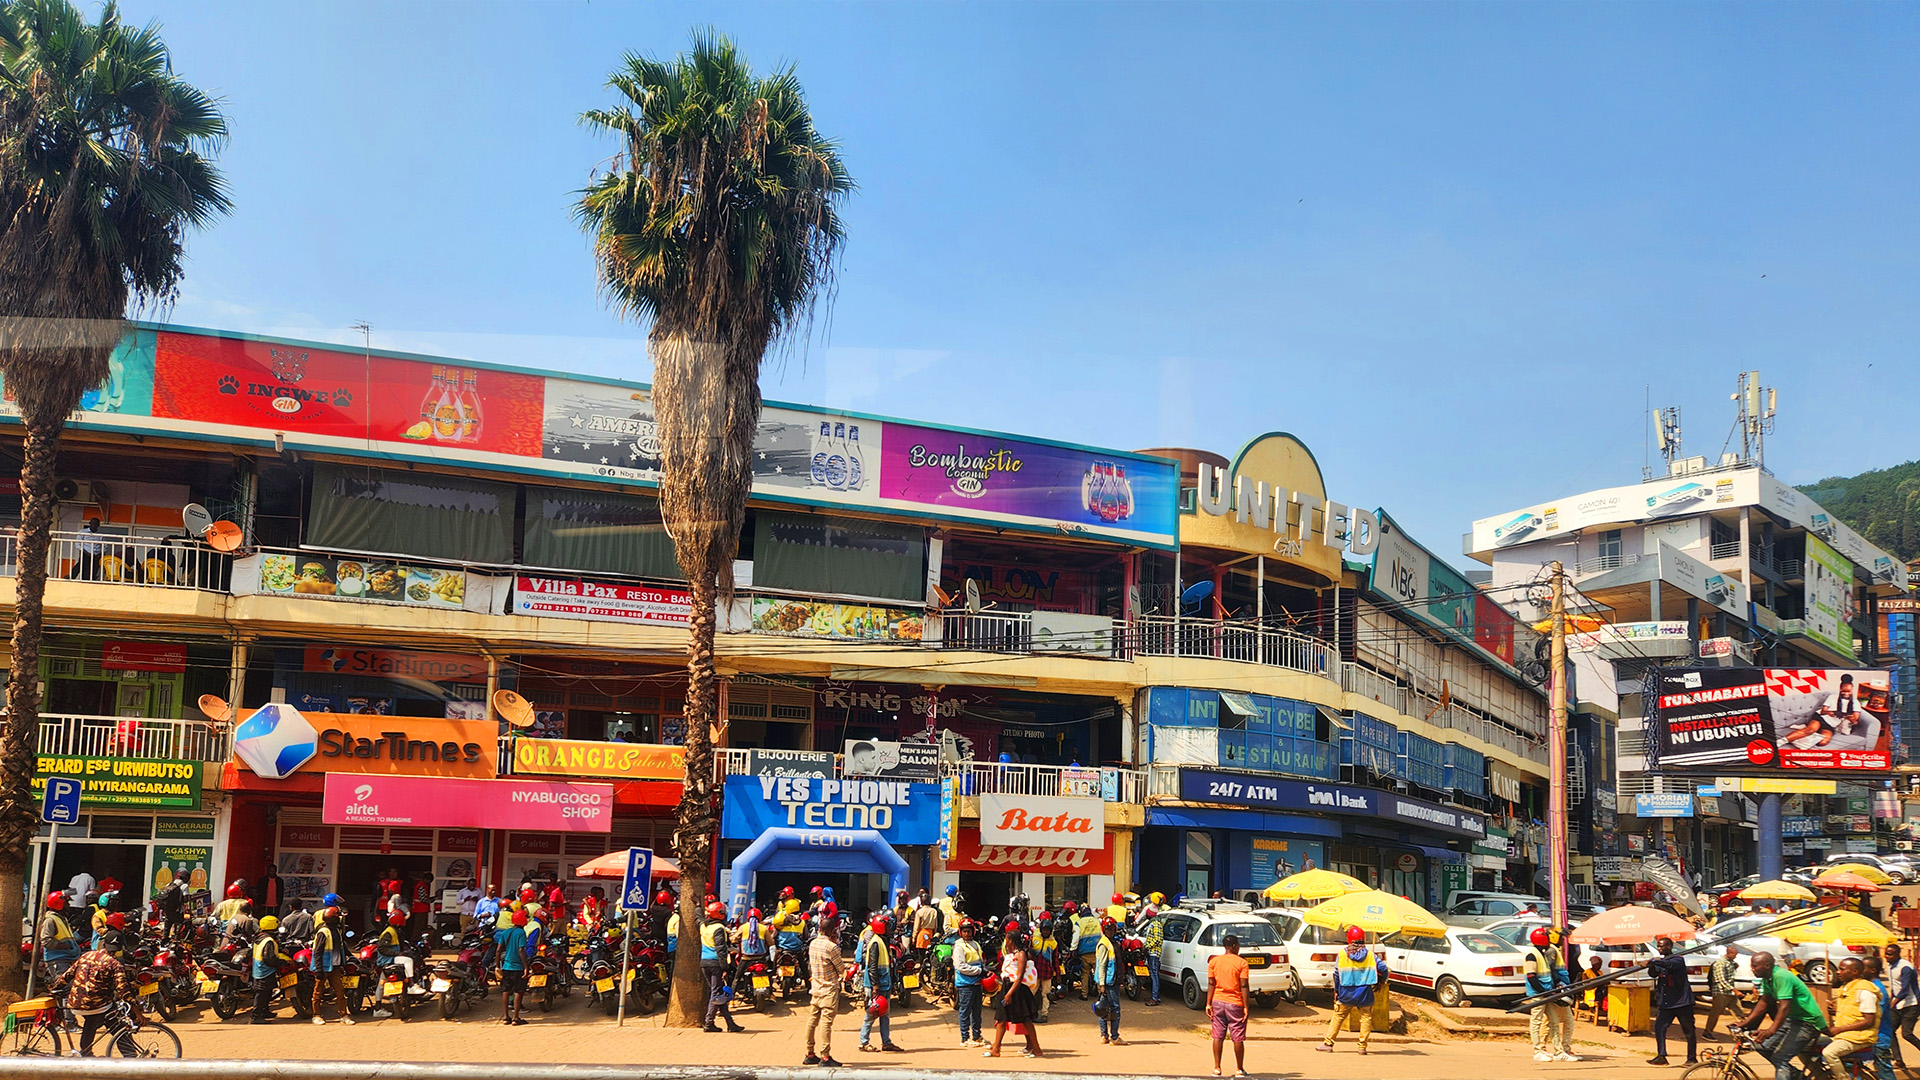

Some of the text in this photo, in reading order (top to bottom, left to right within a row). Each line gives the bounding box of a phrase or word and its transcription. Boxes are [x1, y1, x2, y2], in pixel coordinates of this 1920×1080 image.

[248, 383, 329, 403] INGWE
[248, 402, 324, 420] THE PATRON DRINK
[275, 399, 297, 410] GIN
[909, 444, 1025, 474] Bombastic
[946, 466, 990, 479] Coconut
[959, 480, 978, 490] GIN
[1197, 462, 1381, 555] UNITED
[1578, 498, 1606, 511] CAMON
[1273, 536, 1304, 558] GIN
[941, 563, 1059, 602] SALON
[1391, 557, 1416, 601] NBG
[529, 578, 618, 599] Villa Pax
[548, 596, 570, 604] Catering
[622, 602, 645, 610] Beverage
[626, 591, 662, 602] RESTO
[670, 594, 693, 605] BAR
[352, 650, 472, 679] StarTimes
[733, 677, 798, 687] BIJOUTERIE
[825, 690, 902, 712] KING
[911, 695, 968, 718] SAON
[1669, 713, 1760, 732] INSTALLATION
[1003, 729, 1045, 738] STUDIO PHOTO
[1671, 723, 1763, 745] NI UBUNTU!
[321, 728, 480, 763] StarTimes
[520, 745, 667, 771] ORANGE Salon
[757, 750, 827, 762] BIJOUTERIE
[900, 756, 937, 765] SALON
[1225, 744, 1327, 771] RESTAURANT
[37, 758, 194, 779] ERARD Ese URWIBUTSO
[757, 766, 813, 778] La Brillante
[55, 782, 72, 800] P
[89, 781, 190, 795] NYIRANGARAMA
[759, 777, 910, 805] YES PHONE
[1209, 782, 1278, 801] 24/7 ATM
[1492, 771, 1520, 802] KING
[512, 791, 601, 805] NYABUGOGO
[1341, 794, 1368, 809] Bank
[345, 804, 379, 816] airtel
[562, 807, 600, 818] SHOP
[781, 801, 892, 829] TECNO
[996, 808, 1094, 833] Bata
[299, 832, 320, 840] airtel
[456, 836, 477, 845] airtel
[528, 839, 549, 848] airtel
[798, 833, 853, 847] TECNO
[164, 847, 207, 855] AGASHYA
[972, 846, 1089, 868] Bata
[633, 853, 646, 878] P
